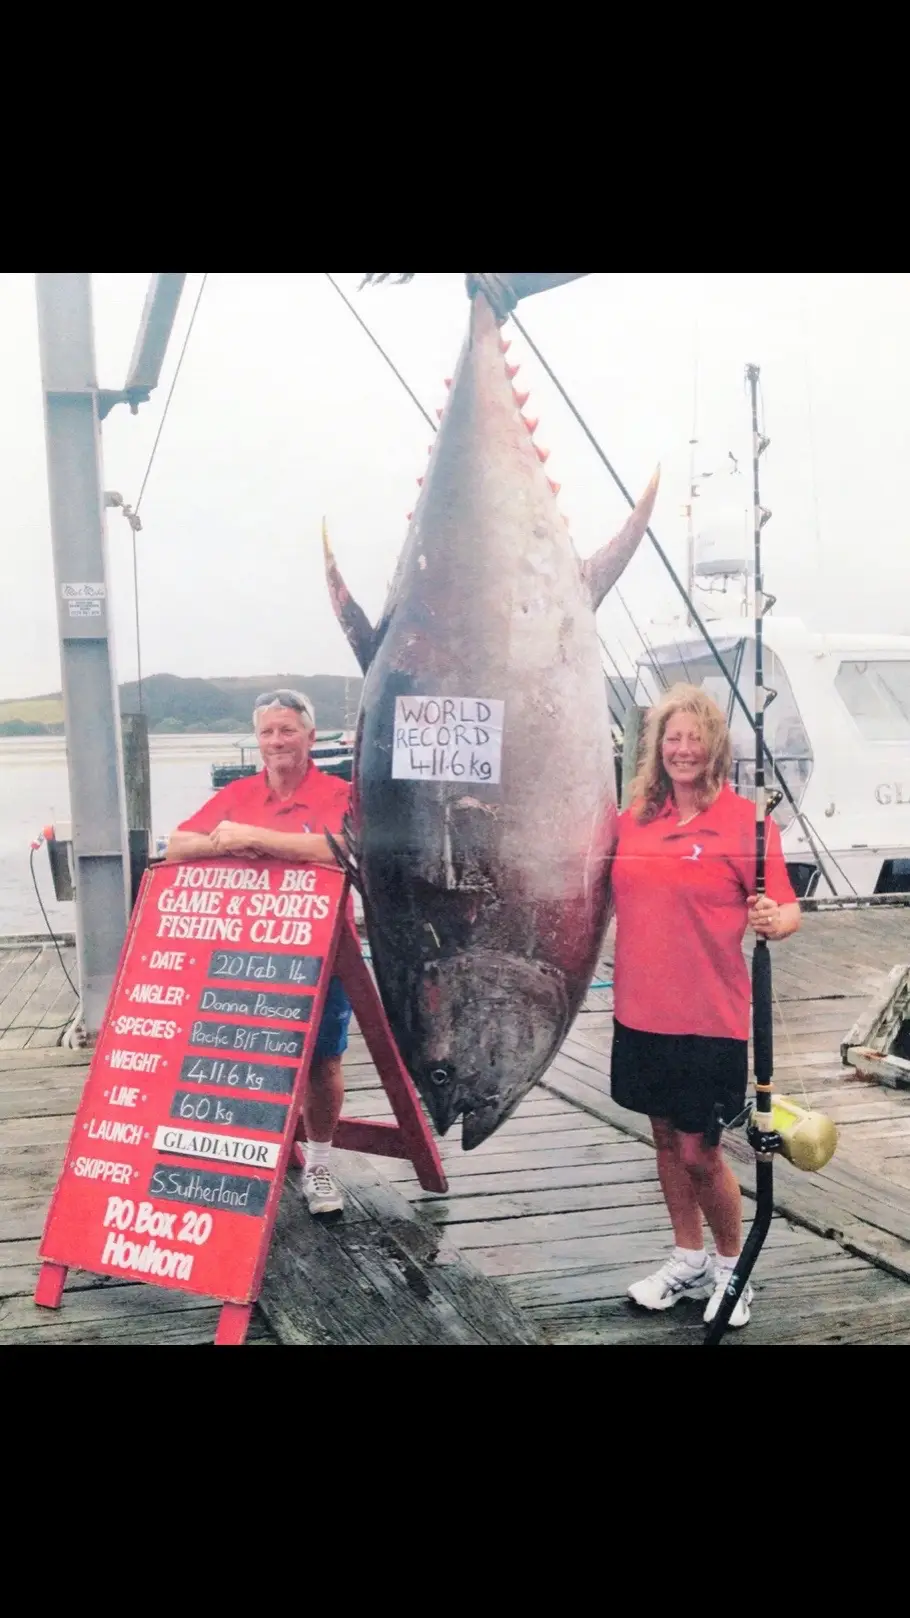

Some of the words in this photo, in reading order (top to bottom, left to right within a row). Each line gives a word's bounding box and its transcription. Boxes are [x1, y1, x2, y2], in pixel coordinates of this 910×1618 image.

[400, 699, 492, 725] WORLD
[396, 725, 490, 748] RECORD
[409, 748, 465, 776] 411.6
[874, 782, 910, 806] GL
[174, 866, 271, 891] HOUHORA
[279, 870, 317, 892] BIG
[157, 889, 225, 915] GAME
[226, 895, 245, 915] &
[246, 894, 330, 920] SPORTS
[156, 915, 244, 942] FISHING
[250, 919, 312, 945] CLUB
[149, 951, 186, 970] DATE
[213, 954, 244, 976] 20
[245, 955, 277, 979] Feb
[288, 959, 306, 983] 14
[128, 983, 185, 1006] ANGLER
[200, 991, 249, 1013] Donna
[253, 993, 301, 1019] Pascoe
[115, 1015, 177, 1039] SPECIES
[233, 1028, 260, 1051] B/F
[261, 1030, 298, 1053] Tuna
[109, 1050, 162, 1073] WEIGHT
[187, 1059, 240, 1086] 411.6
[246, 1066, 265, 1090] kg
[108, 1086, 140, 1107] LINE
[179, 1093, 211, 1120] 60
[215, 1104, 234, 1125] kg
[88, 1119, 143, 1145] LAUNCH
[163, 1131, 269, 1163] GLADIATOR
[74, 1156, 133, 1185] SKIPPER
[177, 1210, 213, 1246] 20
[101, 1232, 194, 1281] Houhora
